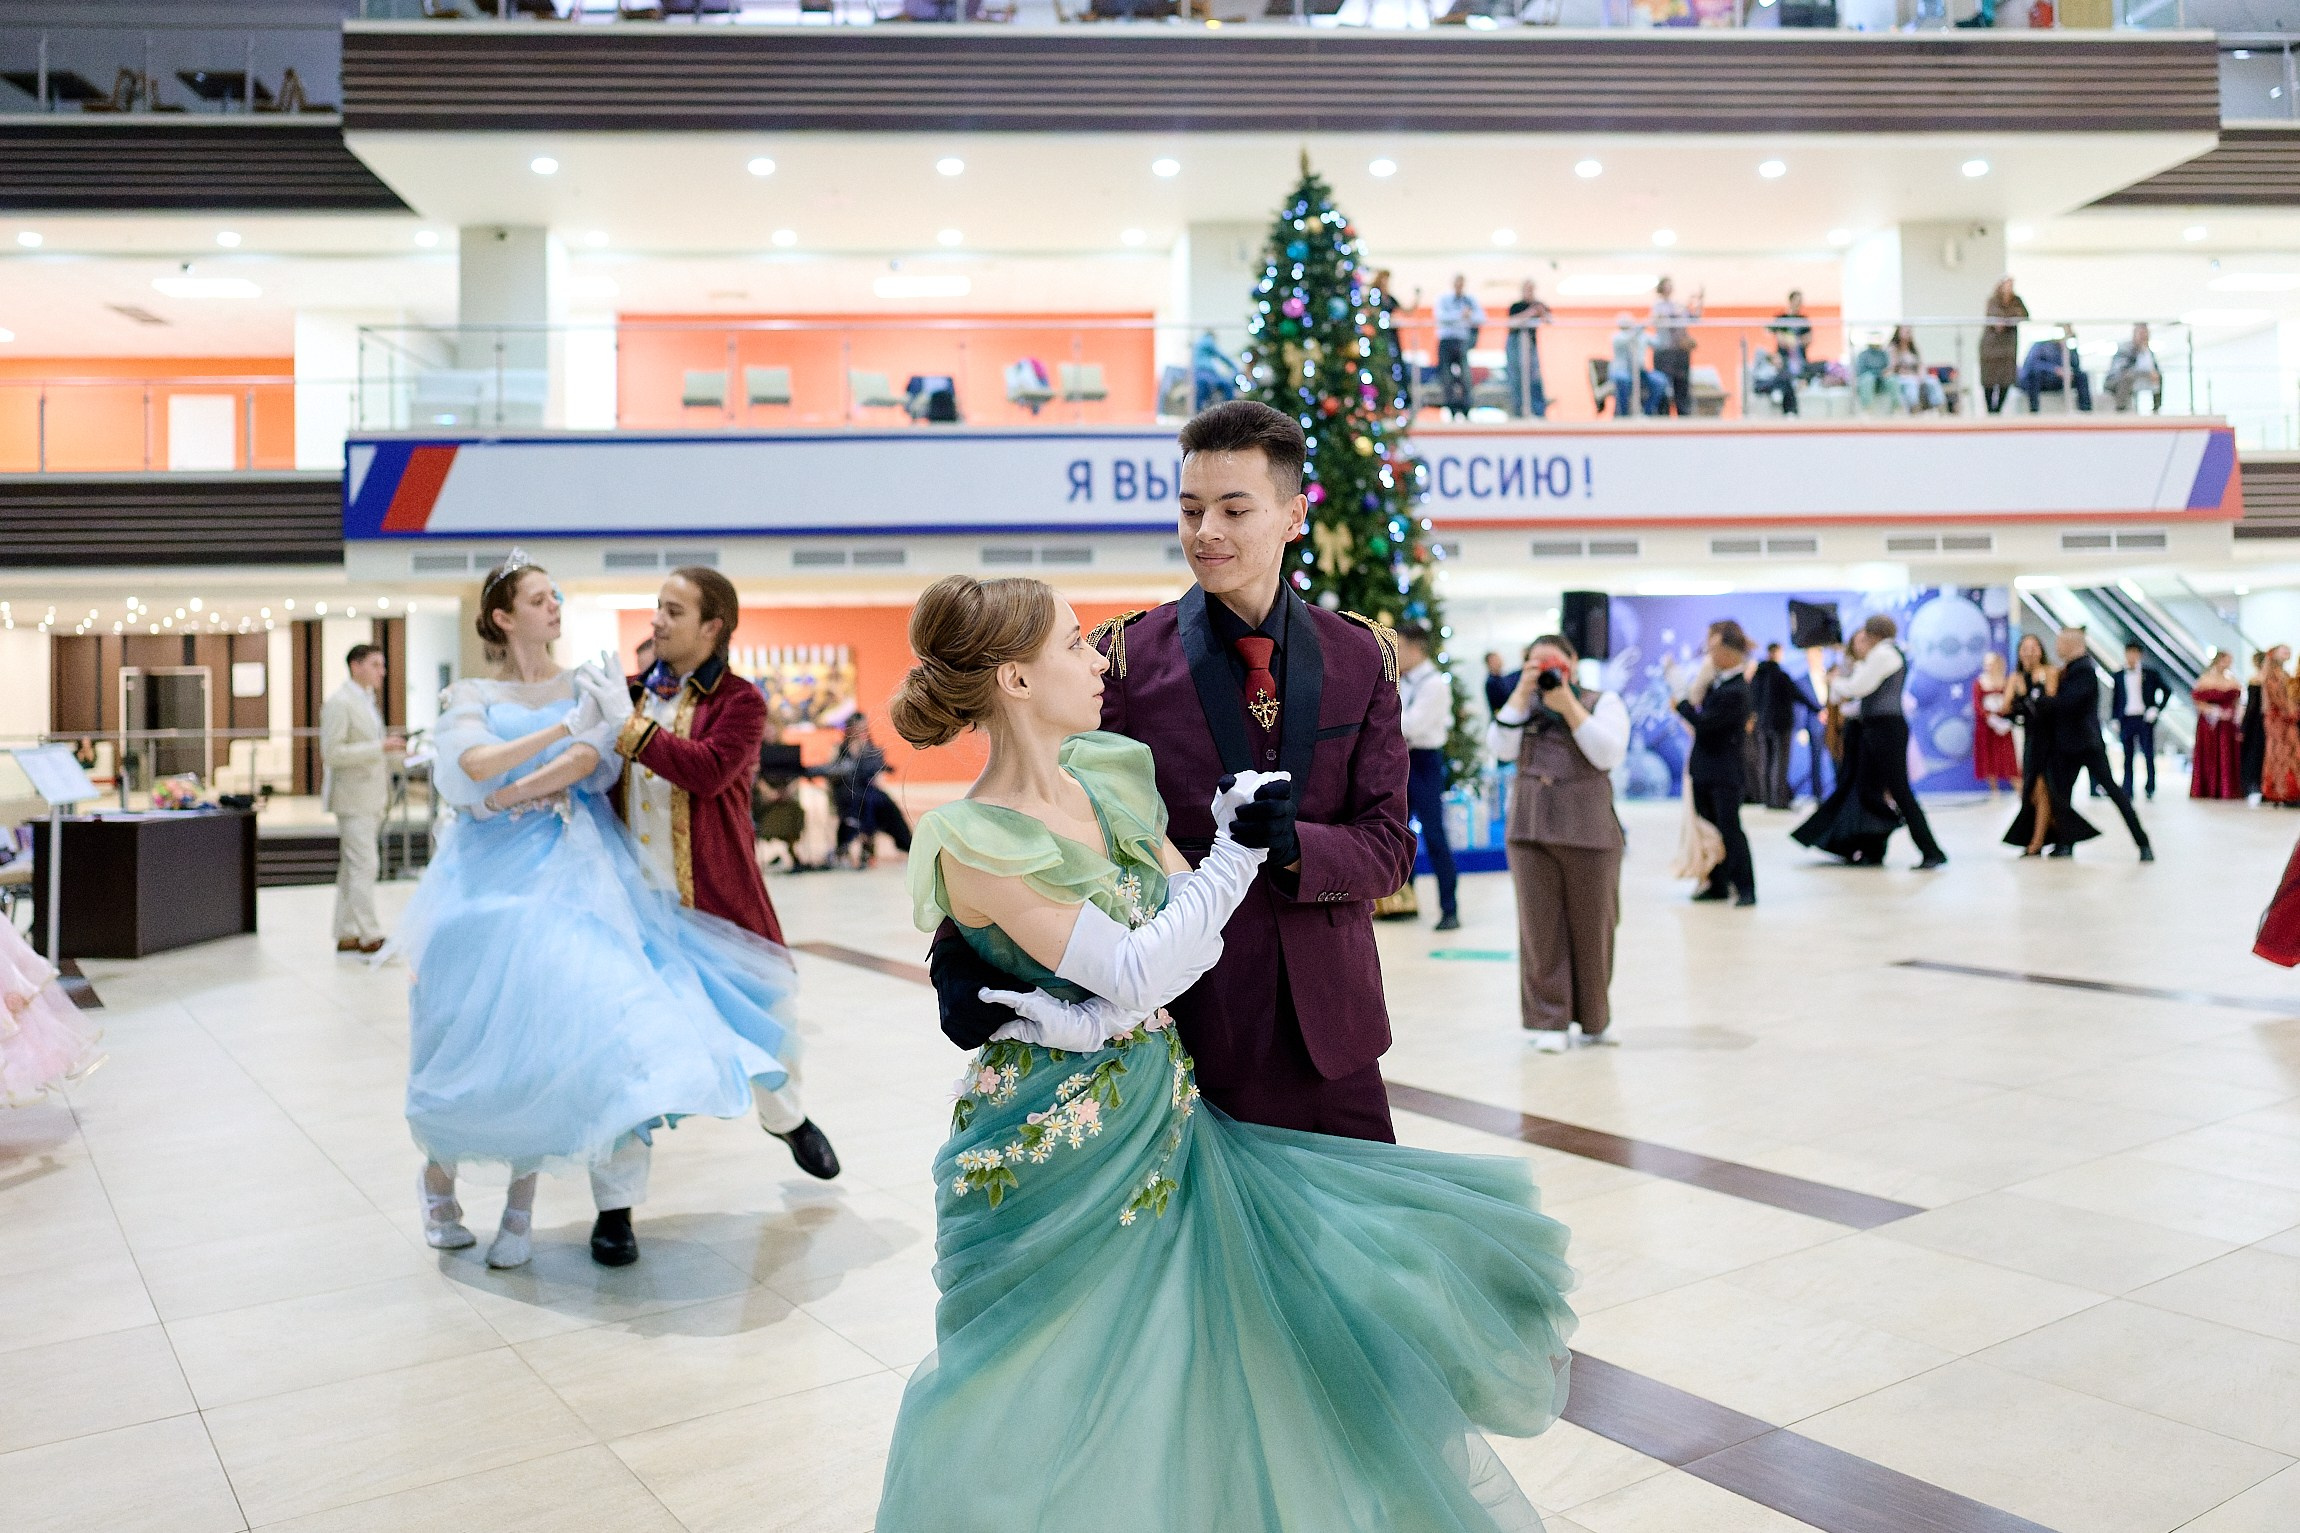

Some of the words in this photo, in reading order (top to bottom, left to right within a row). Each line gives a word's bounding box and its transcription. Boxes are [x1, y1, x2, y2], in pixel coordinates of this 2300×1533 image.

[1067, 459, 1093, 501] Я
[1114, 459, 1180, 501] ВЫ
[1411, 456, 1592, 498] ОССИЮ!
